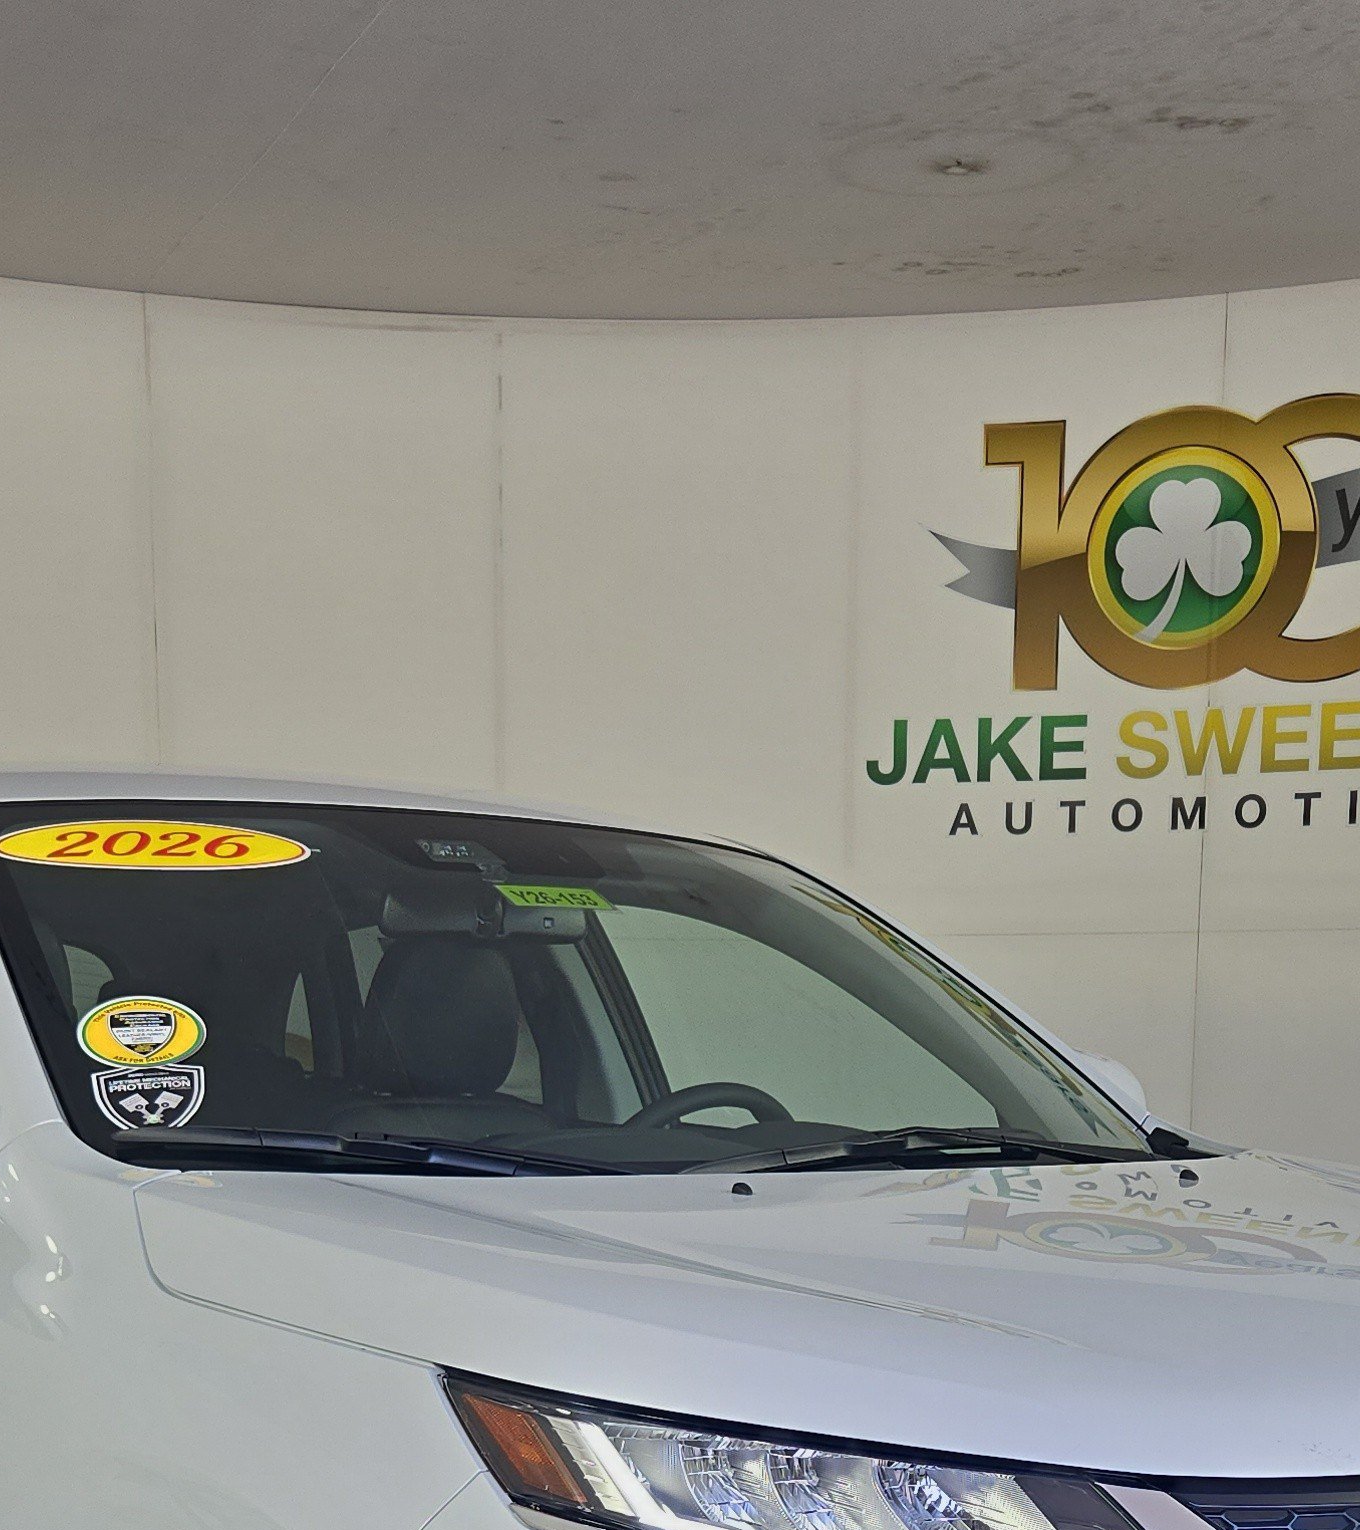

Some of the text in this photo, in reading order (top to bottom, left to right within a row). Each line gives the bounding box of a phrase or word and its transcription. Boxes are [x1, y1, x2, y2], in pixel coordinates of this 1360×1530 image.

[866, 713, 1088, 785] JAKE
[47, 830, 255, 859] 2026
[108, 1080, 191, 1093] PROTECTION
